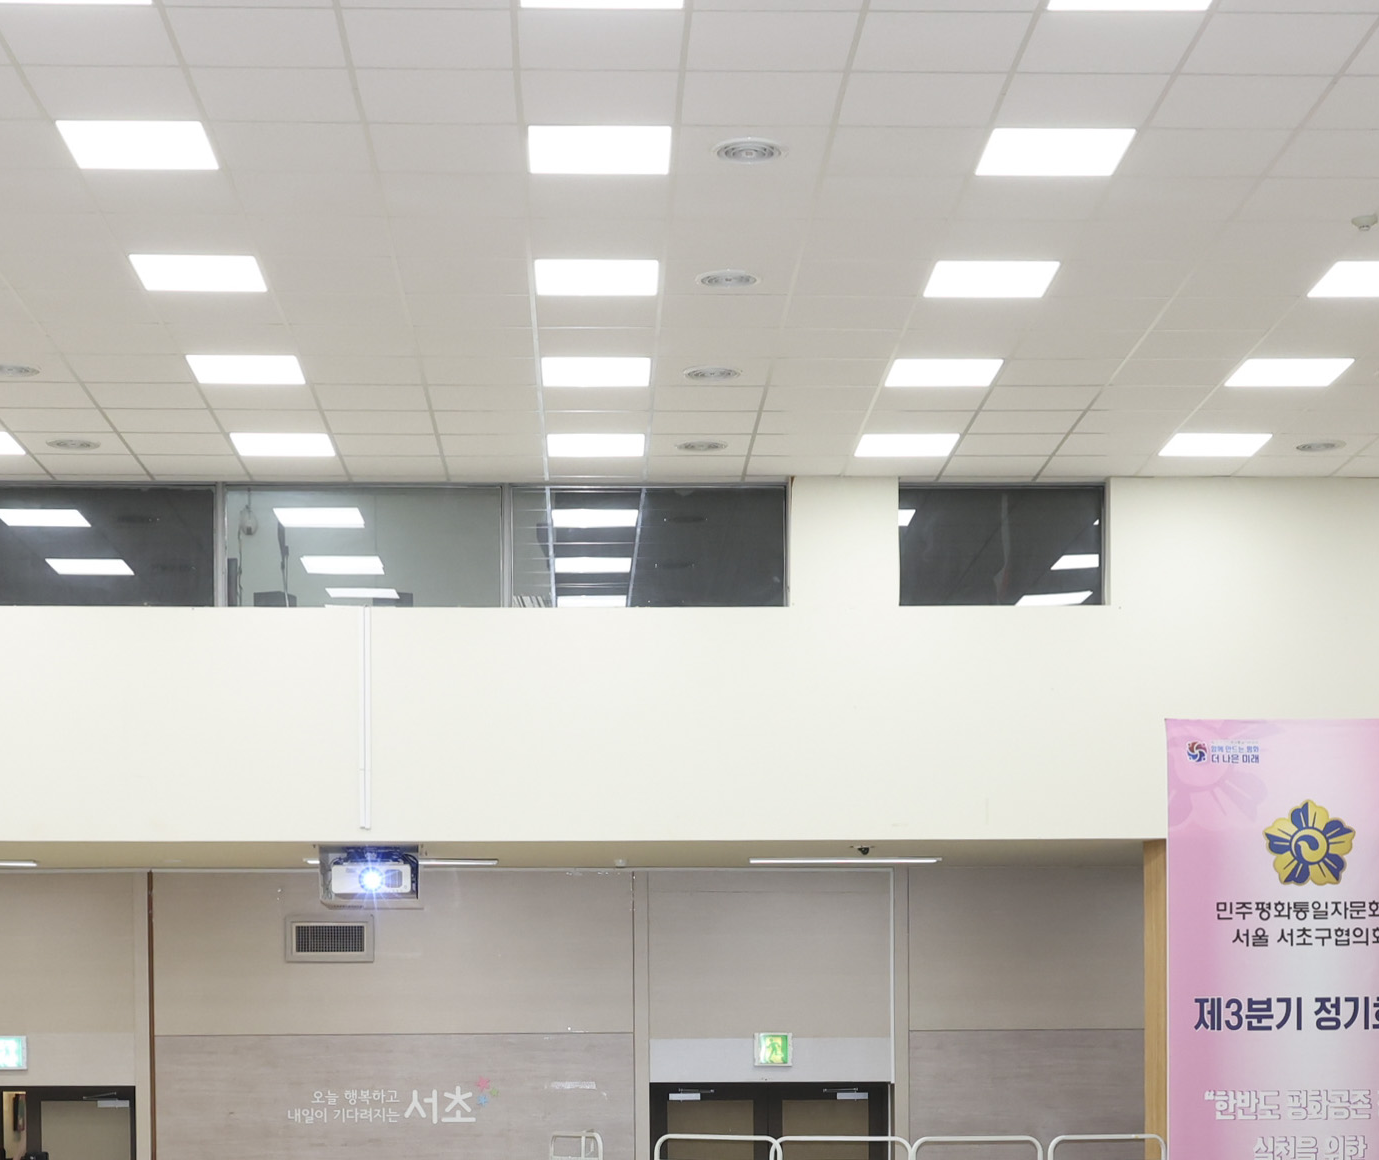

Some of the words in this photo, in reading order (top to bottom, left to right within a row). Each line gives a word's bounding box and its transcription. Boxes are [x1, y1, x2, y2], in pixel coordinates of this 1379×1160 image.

[1211, 754, 1219, 763] 더
[1222, 754, 1239, 763] 나은
[1242, 754, 1259, 763] 미래
[1232, 927, 1269, 947] 서울
[1194, 997, 1303, 1031] 제3분기
[311, 1090, 339, 1105] 오늘
[344, 1089, 400, 1105] 행복하고
[404, 1085, 477, 1125] 서초
[1287, 1089, 1373, 1120] 평화공존
[287, 1108, 328, 1124] 내일이
[333, 1107, 400, 1124] 기다려지는
